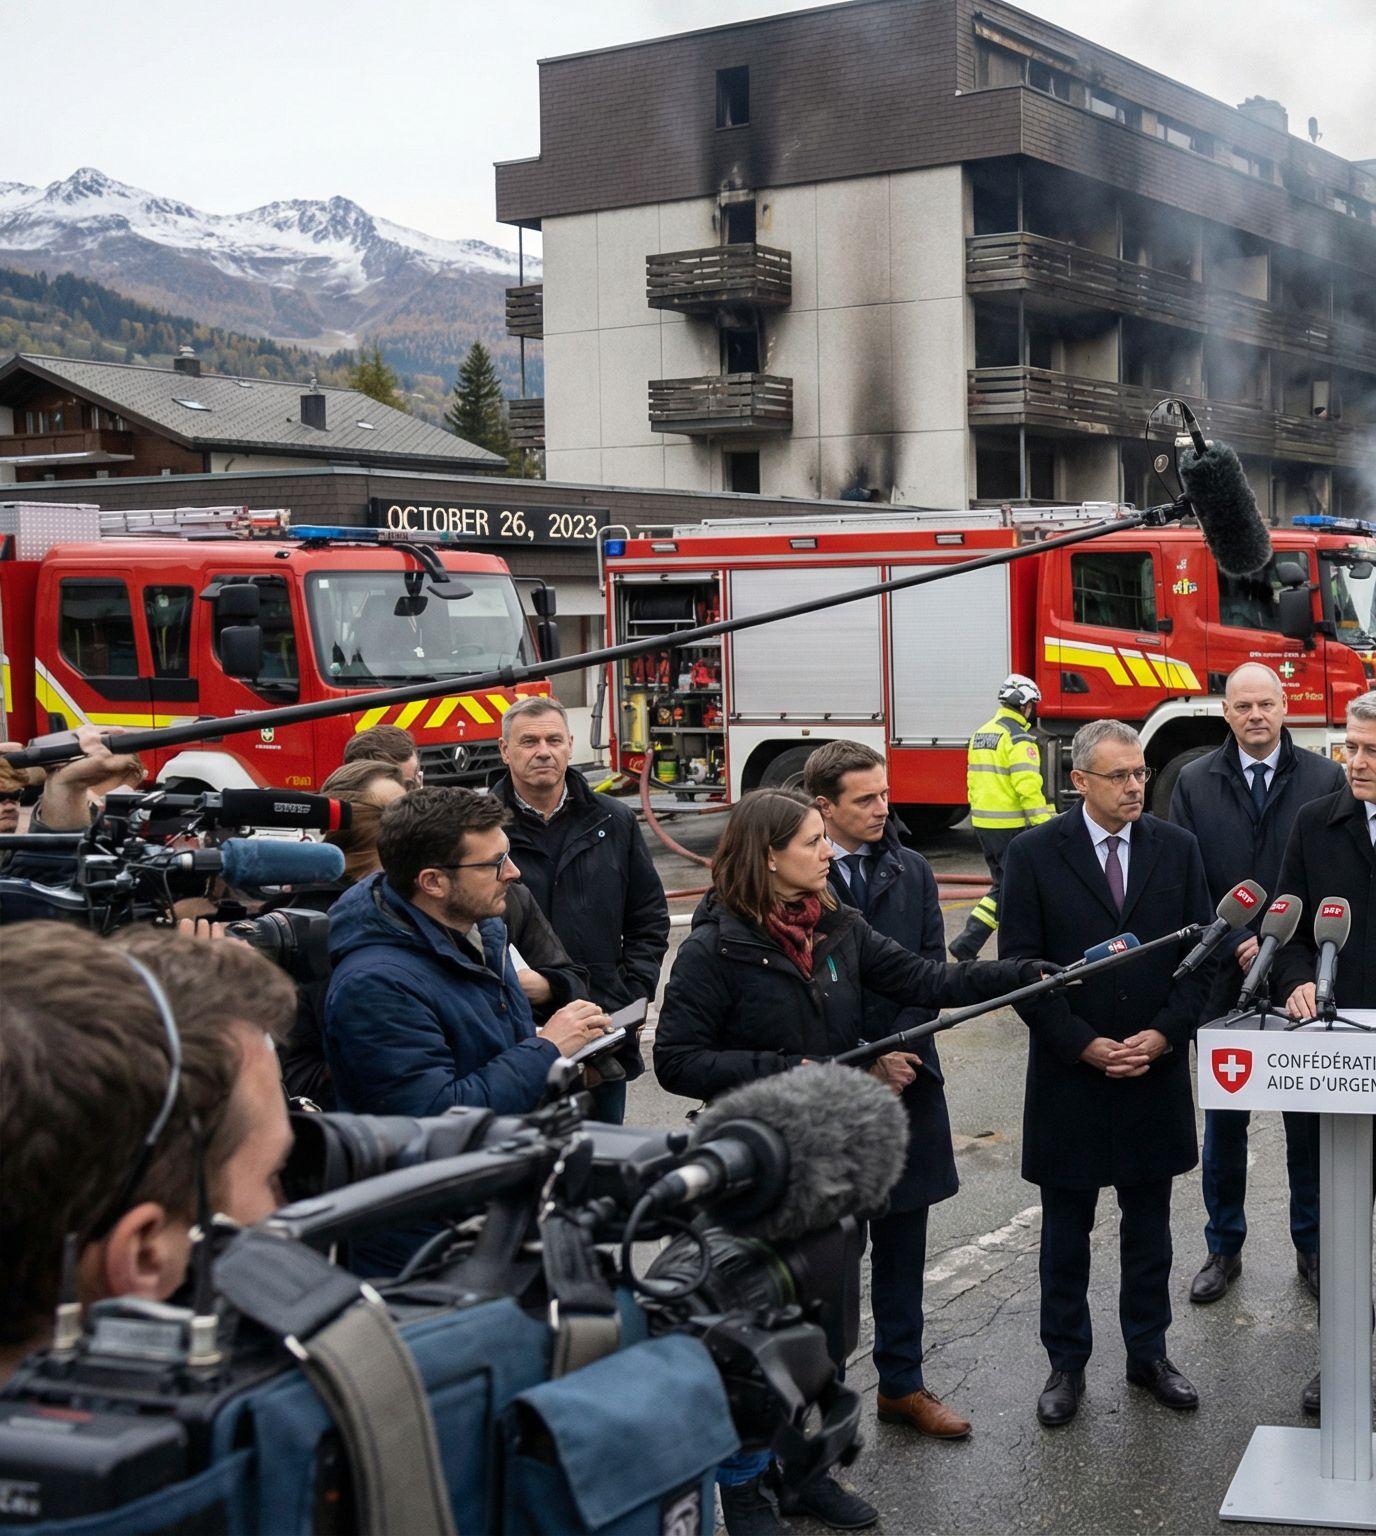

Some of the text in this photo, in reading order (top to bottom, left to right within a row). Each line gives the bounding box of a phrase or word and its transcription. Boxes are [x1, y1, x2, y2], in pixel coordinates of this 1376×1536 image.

[387, 505, 598, 542] OCTOBER 26, 2023
[1266, 1075, 1304, 1091] AIDE
